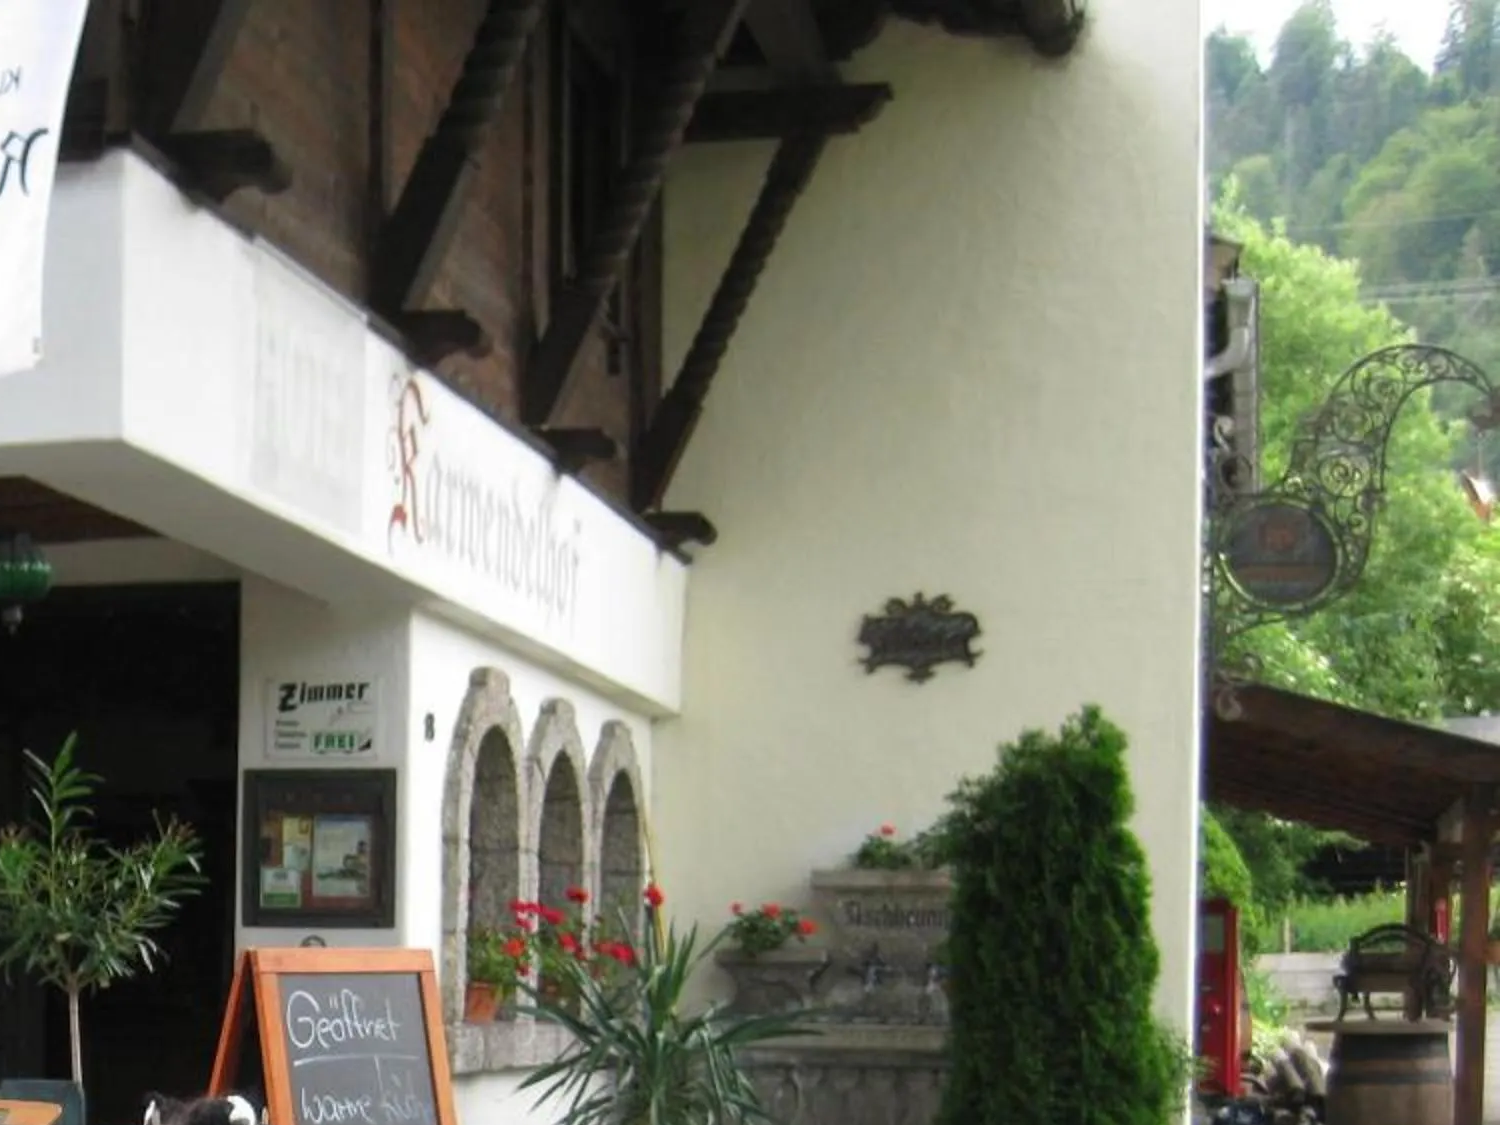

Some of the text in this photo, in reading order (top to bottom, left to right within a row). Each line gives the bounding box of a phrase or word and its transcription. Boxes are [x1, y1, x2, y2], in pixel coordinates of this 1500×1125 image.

[278, 681, 370, 713] Zimmer
[313, 733, 357, 750] FREI
[286, 989, 401, 1049] Geöffnet
